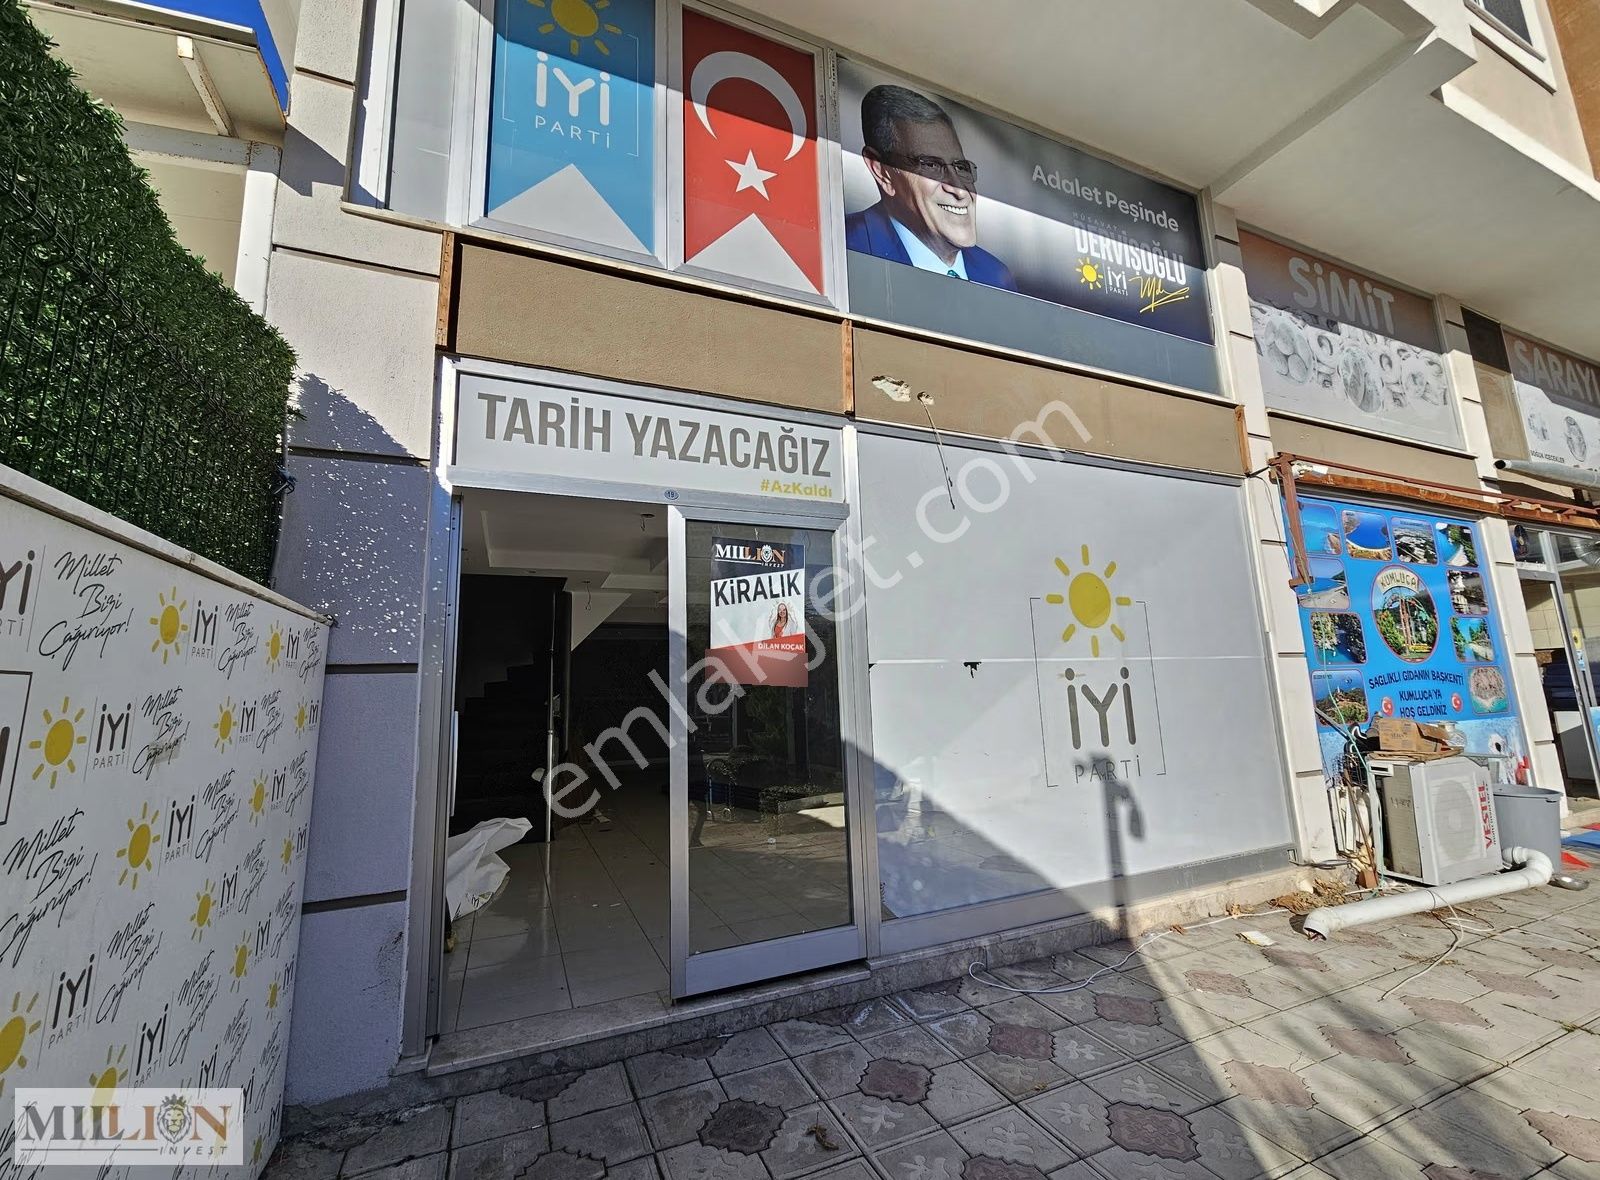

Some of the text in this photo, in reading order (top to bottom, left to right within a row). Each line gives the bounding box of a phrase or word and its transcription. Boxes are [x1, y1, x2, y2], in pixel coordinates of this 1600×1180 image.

[536, 51, 611, 126] İYİ
[535, 115, 610, 149] PARTİ
[1032, 165, 1179, 232] Adalet Peşinde
[1073, 219, 1187, 286] DERVİŞOĞLU
[1107, 266, 1127, 290] İYİ
[1288, 256, 1395, 335] SİMİT
[1514, 340, 1600, 405] SARAYI
[477, 392, 831, 478] TARİH YAZACAĞIZ
[759, 479, 832, 499] #AzKaldı
[0, 550, 35, 615] Yİ
[54, 552, 123, 595] Millet
[76, 583, 123, 620] Bizi
[713, 571, 801, 607] KİRALIK
[193, 600, 218, 646] İYİ
[96, 703, 132, 753] İYİ
[1064, 666, 1137, 750] İYİ
[1400, 705, 1416, 719] HOŞ
[93, 752, 126, 770] PARTİ
[1074, 754, 1141, 784] PARTİ
[167, 795, 195, 848] İYİ
[1478, 780, 1493, 849] VESTEL
[3, 808, 85, 880] Millet
[30, 846, 84, 904] Bizi
[52, 954, 95, 1029] İYİ
[136, 1003, 169, 1076] İYİ
